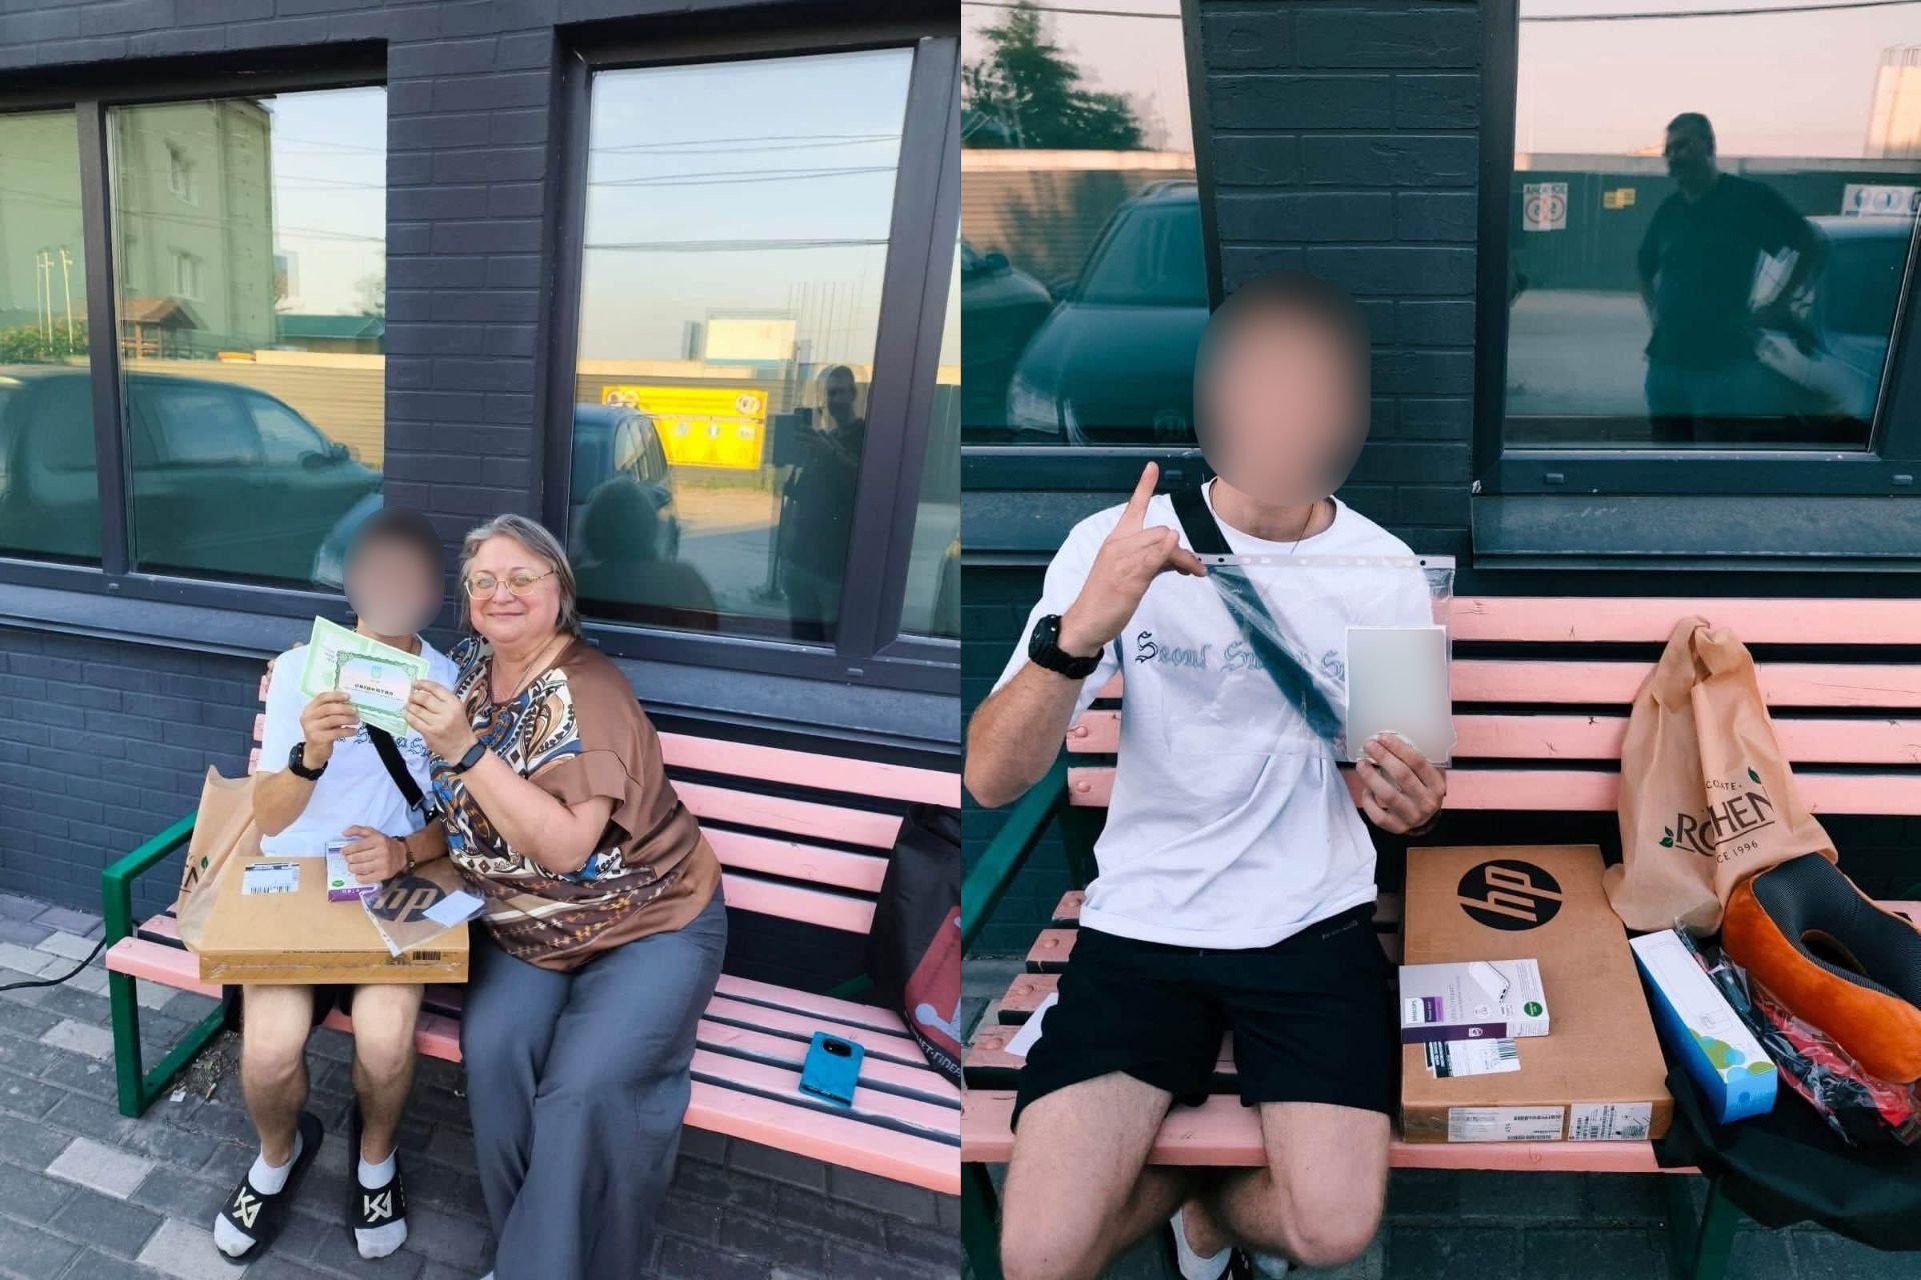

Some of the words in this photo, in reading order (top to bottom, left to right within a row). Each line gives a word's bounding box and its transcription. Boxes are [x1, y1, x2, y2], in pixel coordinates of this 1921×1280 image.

[1716, 851, 1731, 864] CE
[1732, 839, 1759, 857] 1996
[373, 882, 438, 923] hp
[1457, 865, 1563, 922] hp
